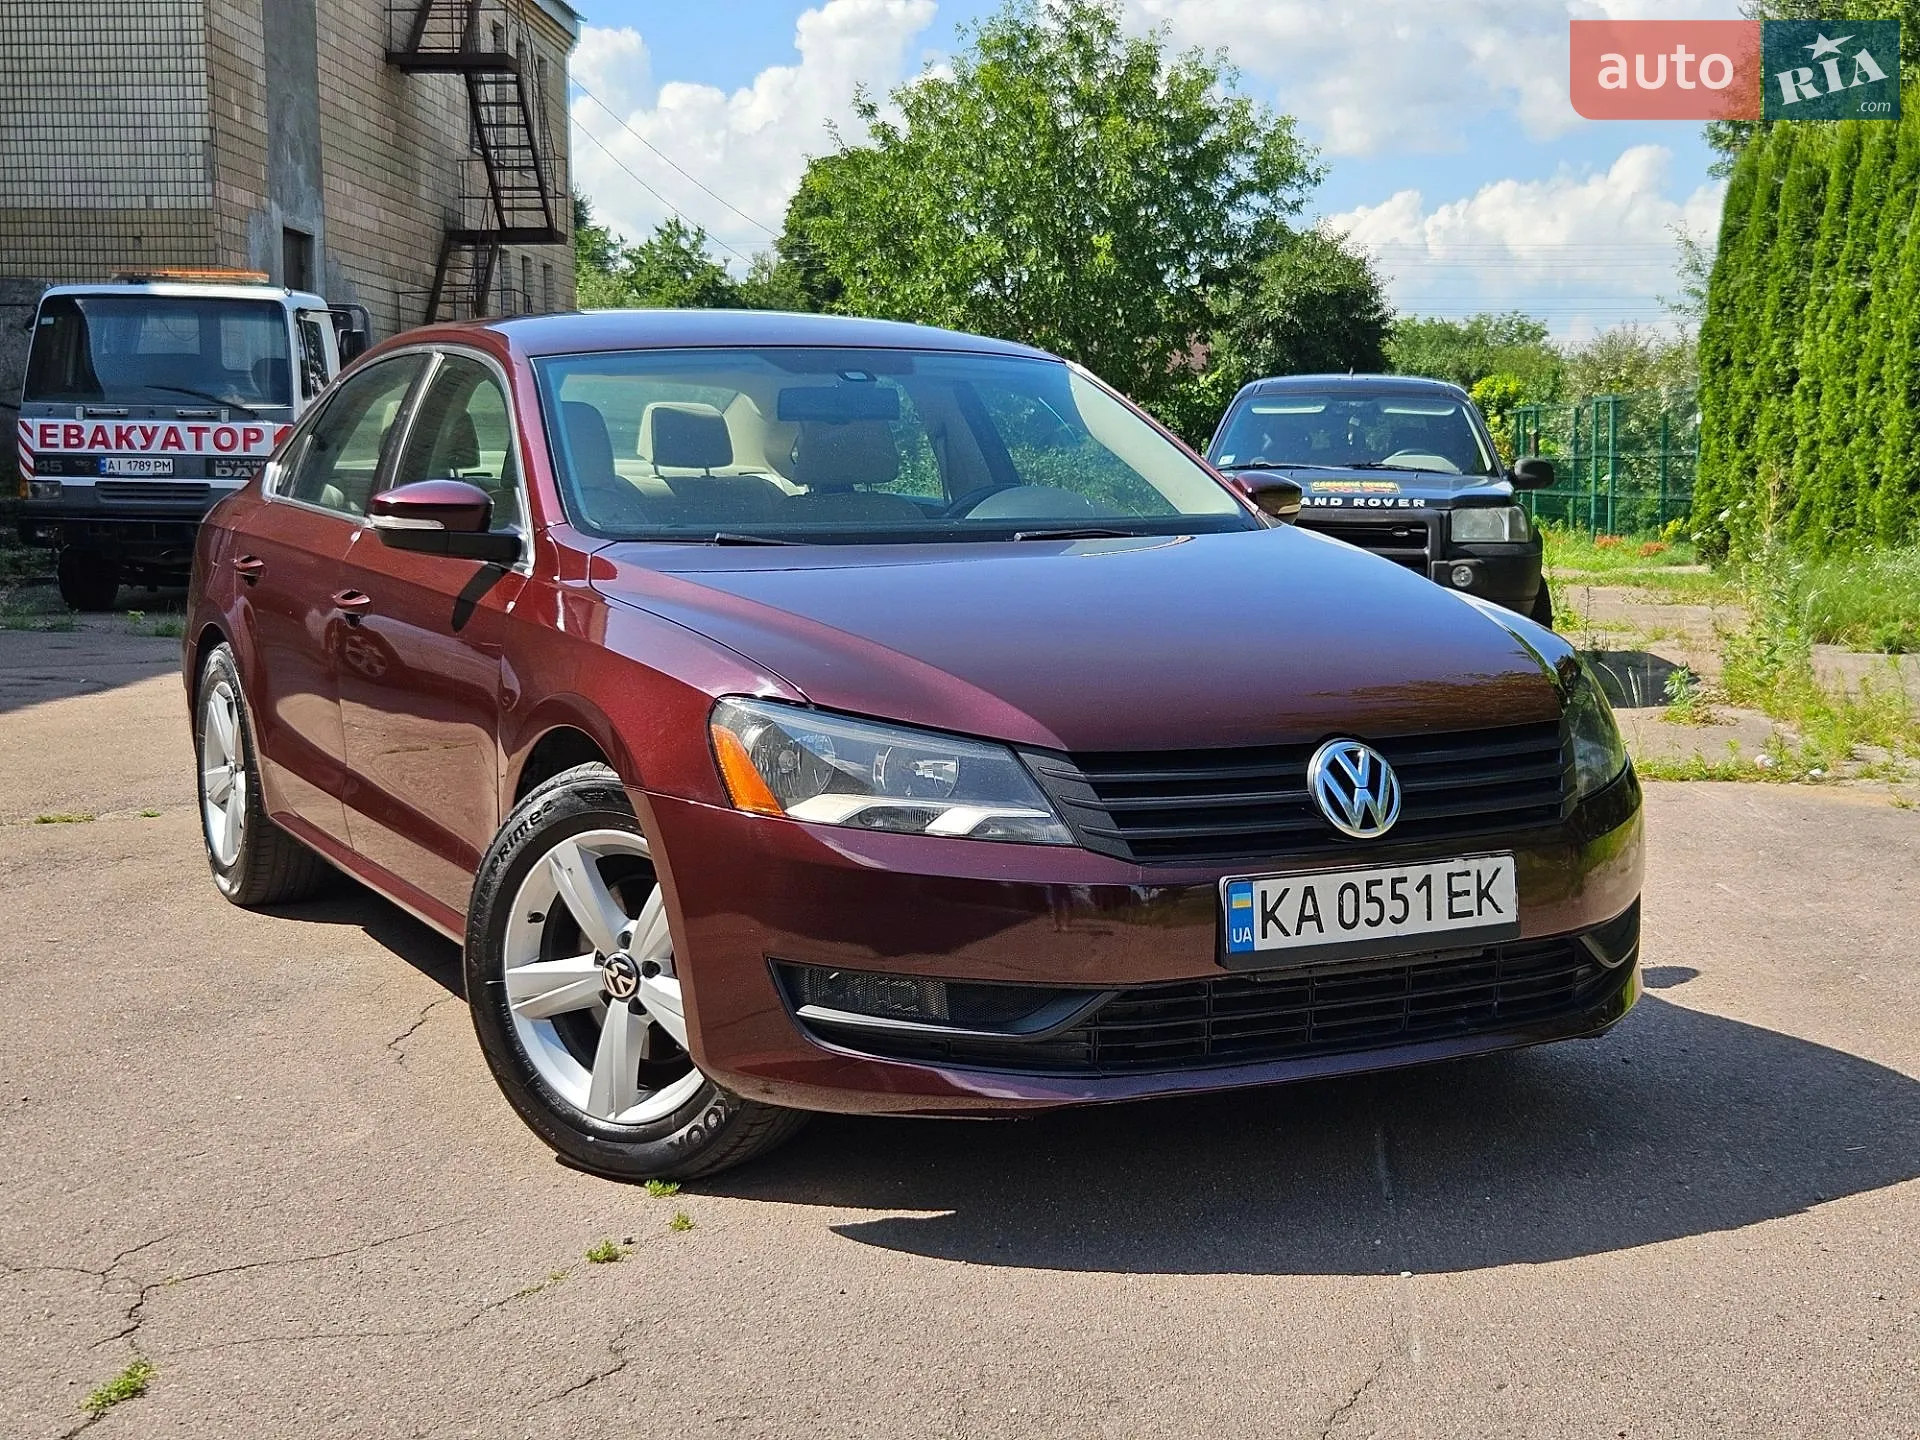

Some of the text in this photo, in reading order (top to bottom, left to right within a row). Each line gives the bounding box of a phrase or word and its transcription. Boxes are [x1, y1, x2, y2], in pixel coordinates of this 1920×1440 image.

[39, 424, 265, 452] ЕВАКУАТОР
[108, 460, 171, 472] AI 1789 PM
[1300, 497, 1425, 507] AND ROVER
[1261, 867, 1504, 939] KA 0551 EK
[1232, 927, 1252, 943] UA
